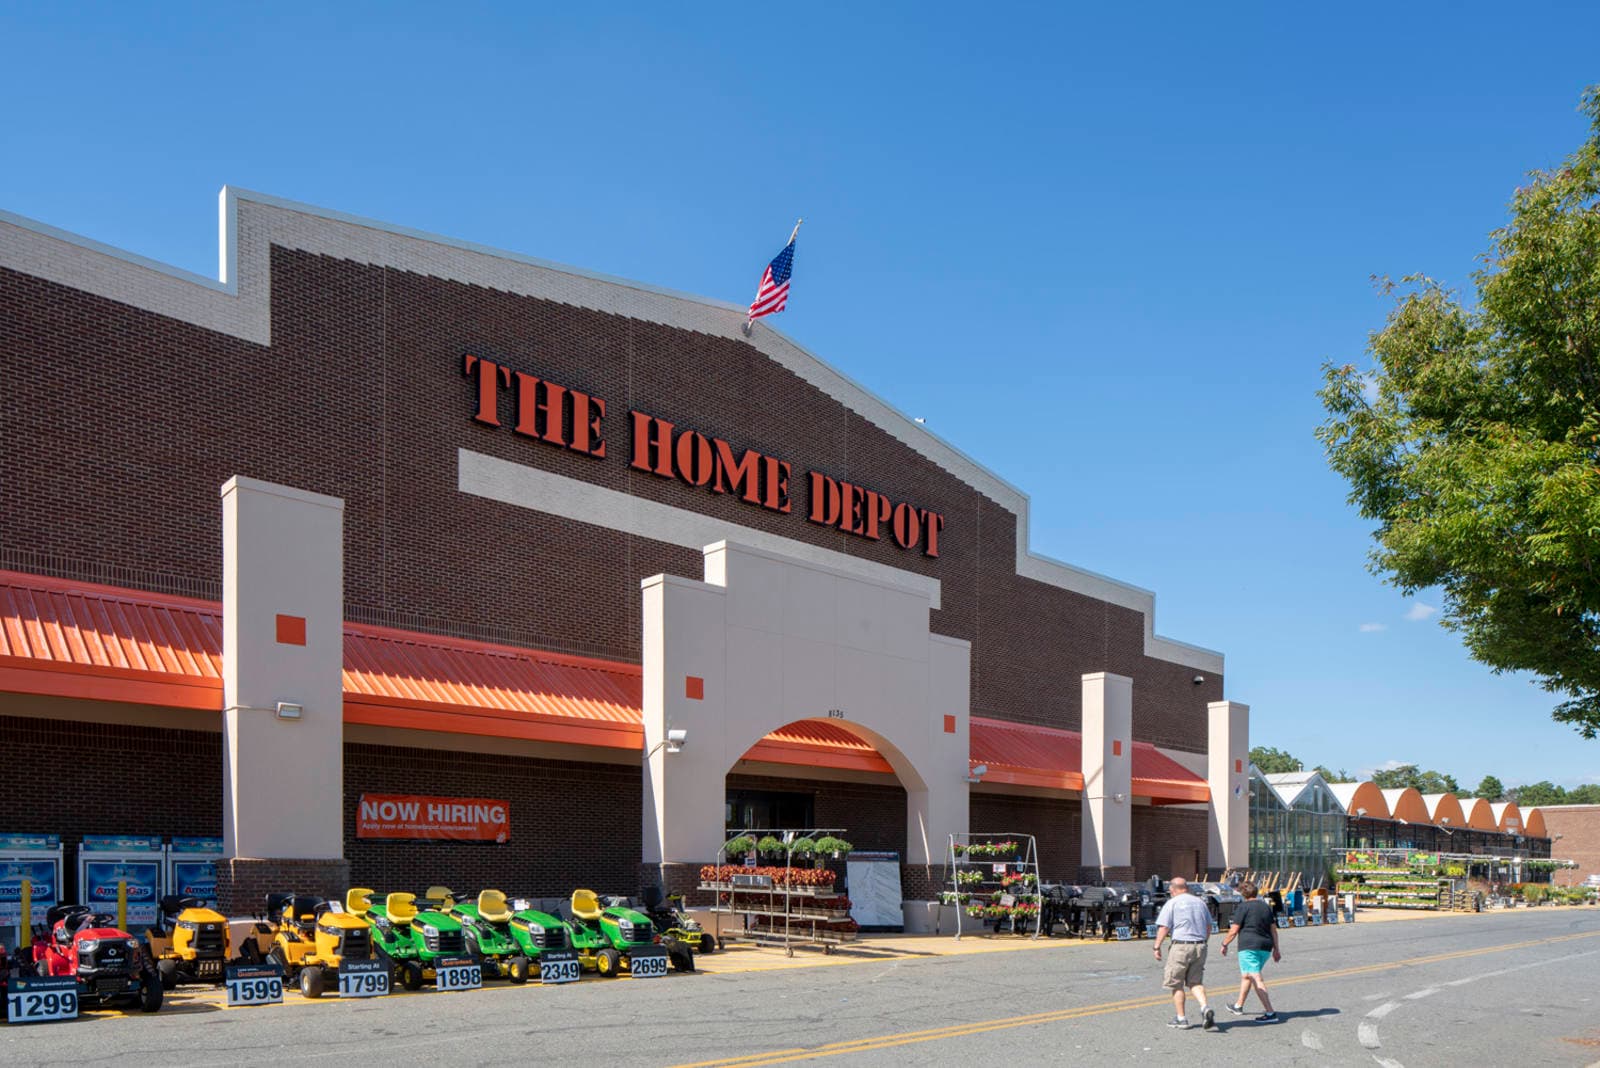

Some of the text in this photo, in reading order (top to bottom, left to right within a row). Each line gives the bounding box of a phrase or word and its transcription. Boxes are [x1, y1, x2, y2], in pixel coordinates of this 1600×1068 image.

[462, 353, 944, 558] THE HOME DEPOT
[361, 801, 506, 824] NOW HIRING
[96, 886, 149, 895] AmeGas
[542, 962, 578, 979] 2349
[633, 958, 666, 974] 2699
[339, 974, 387, 992] 1799
[439, 968, 480, 987] 1898
[227, 980, 282, 1001] 1599
[9, 992, 77, 1017] 1299
